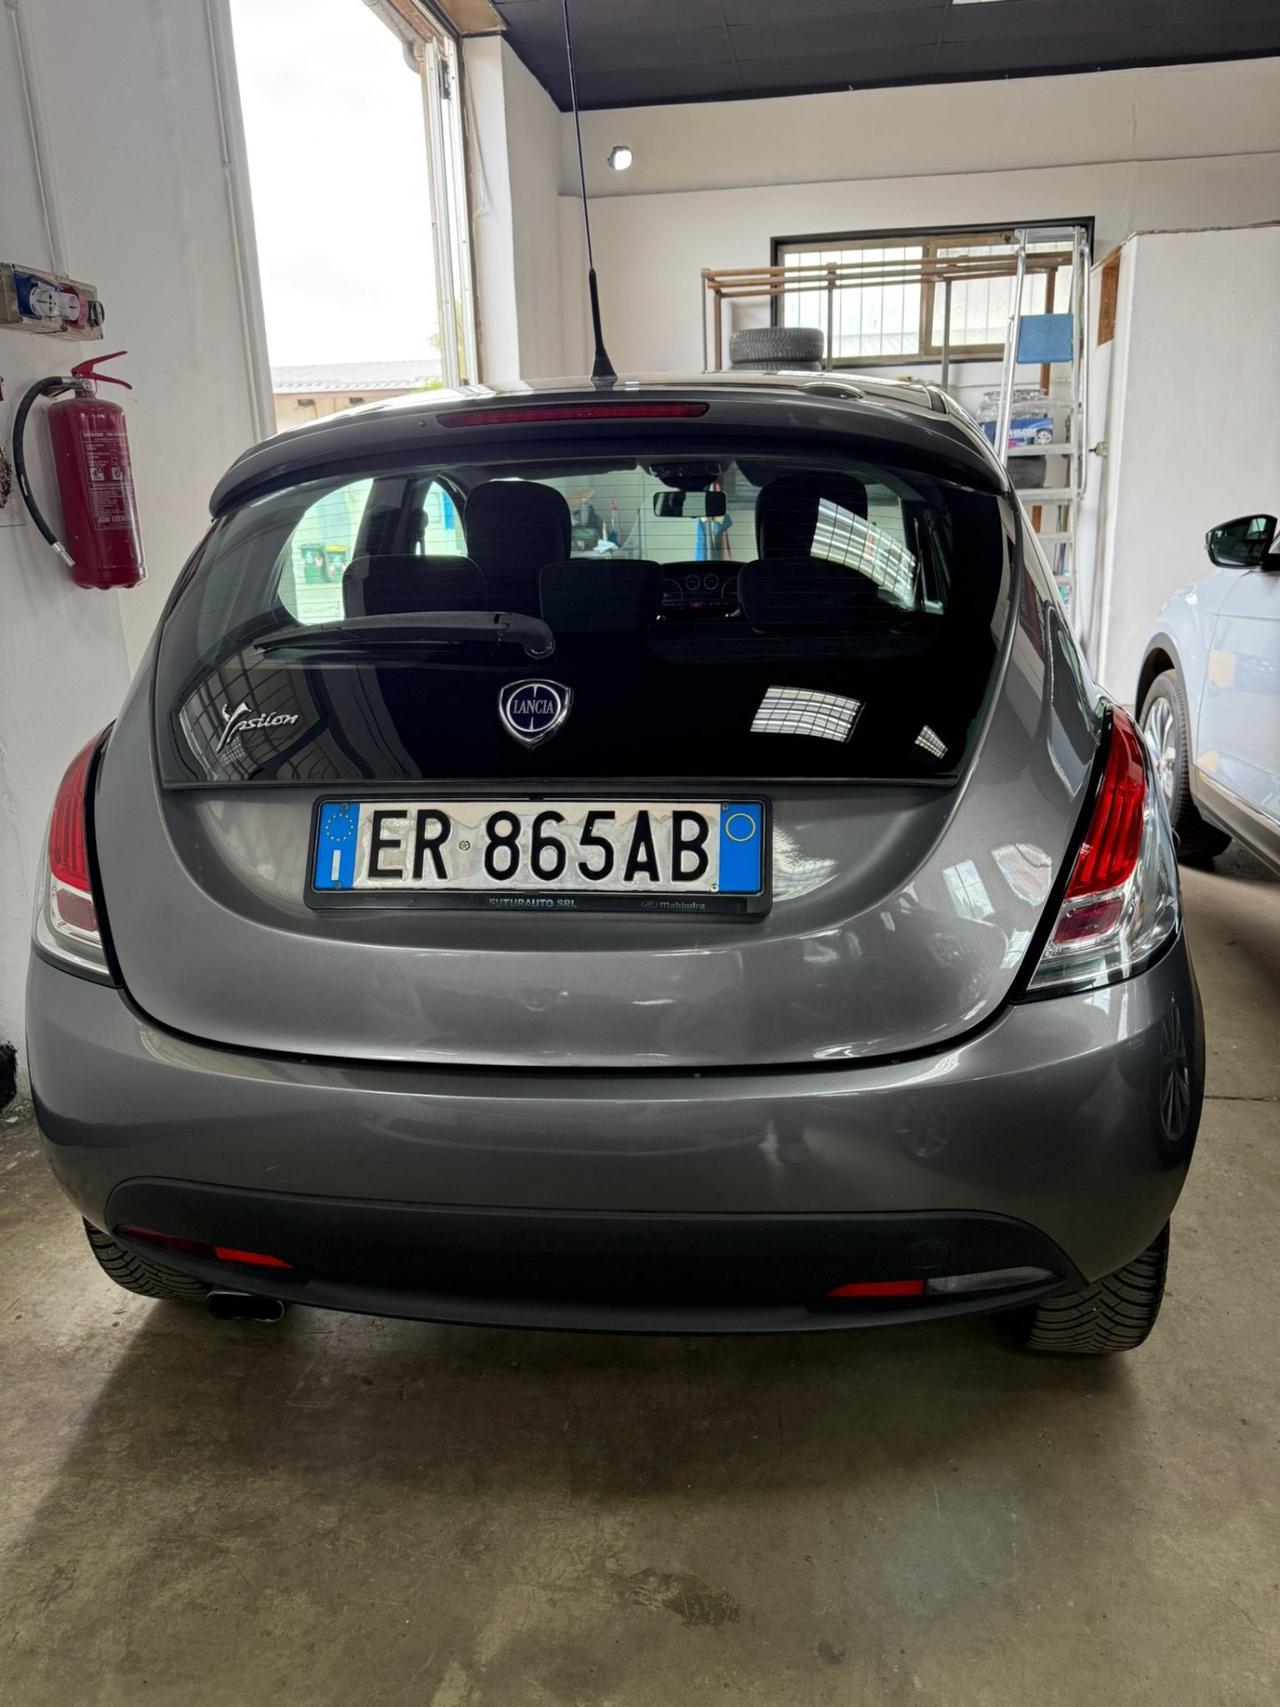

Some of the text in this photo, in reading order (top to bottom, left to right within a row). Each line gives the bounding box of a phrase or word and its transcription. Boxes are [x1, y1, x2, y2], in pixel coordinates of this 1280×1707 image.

[216, 702, 298, 753] Ypsilon
[513, 700, 554, 714] LANCIA
[368, 809, 710, 882] ER 865AB
